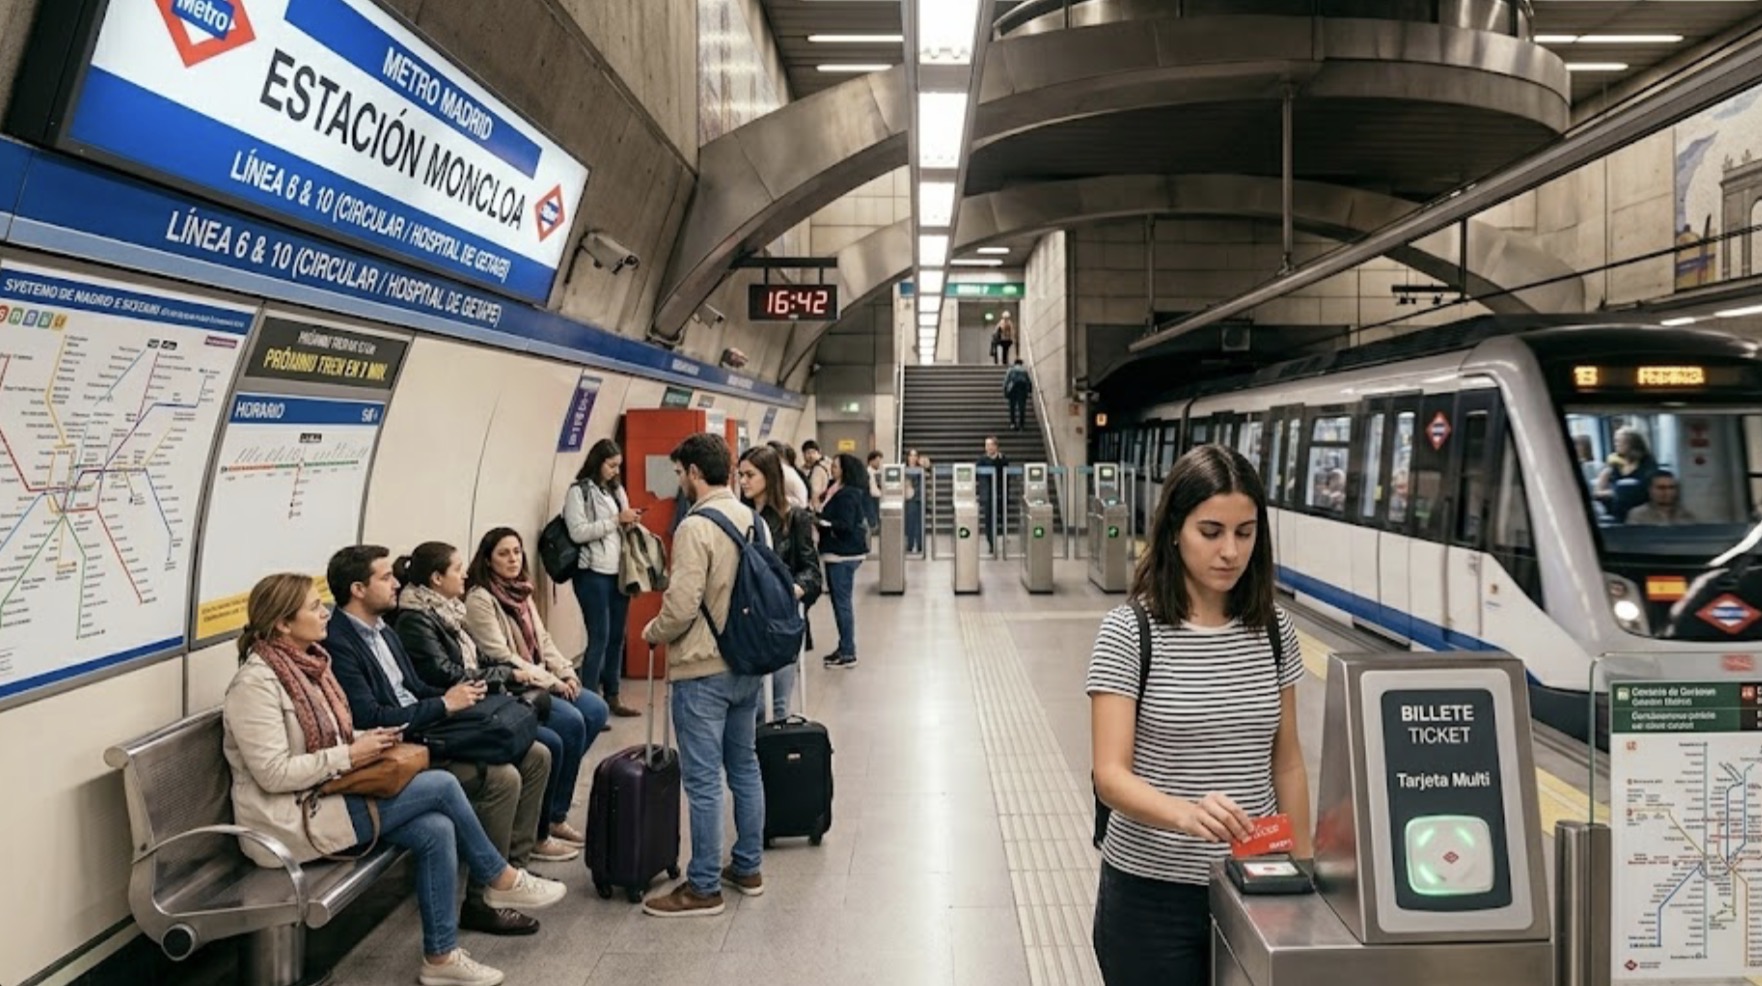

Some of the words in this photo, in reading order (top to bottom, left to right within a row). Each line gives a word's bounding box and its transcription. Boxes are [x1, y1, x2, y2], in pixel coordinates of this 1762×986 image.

[383, 46, 440, 106] METRO
[440, 87, 493, 140] MADRID
[260, 47, 425, 179] ESTACIÓN
[423, 143, 526, 232] MONCLOA
[230, 148, 285, 196] LÍNEA
[286, 174, 300, 200] 6
[298, 180, 313, 207] &
[315, 186, 334, 213] 10
[332, 192, 405, 239] (CIRCULAR
[402, 221, 413, 242] /
[410, 223, 461, 261] HOSPITAL
[165, 207, 232, 255] LÍNEA
[234, 230, 250, 259] 6
[251, 235, 266, 264] &
[271, 241, 293, 270] 10
[292, 247, 379, 294] (CIRCULAR
[377, 271, 389, 294] /
[385, 273, 444, 310] HOSPITAL
[447, 290, 463, 314] DE
[767, 290, 828, 314] 16:42
[235, 401, 285, 419] HORARIO
[1401, 705, 1474, 721] BILLETE
[1408, 726, 1470, 744] TICKET
[1396, 772, 1449, 791] Tarjeta
[1452, 771, 1490, 788] Multi
